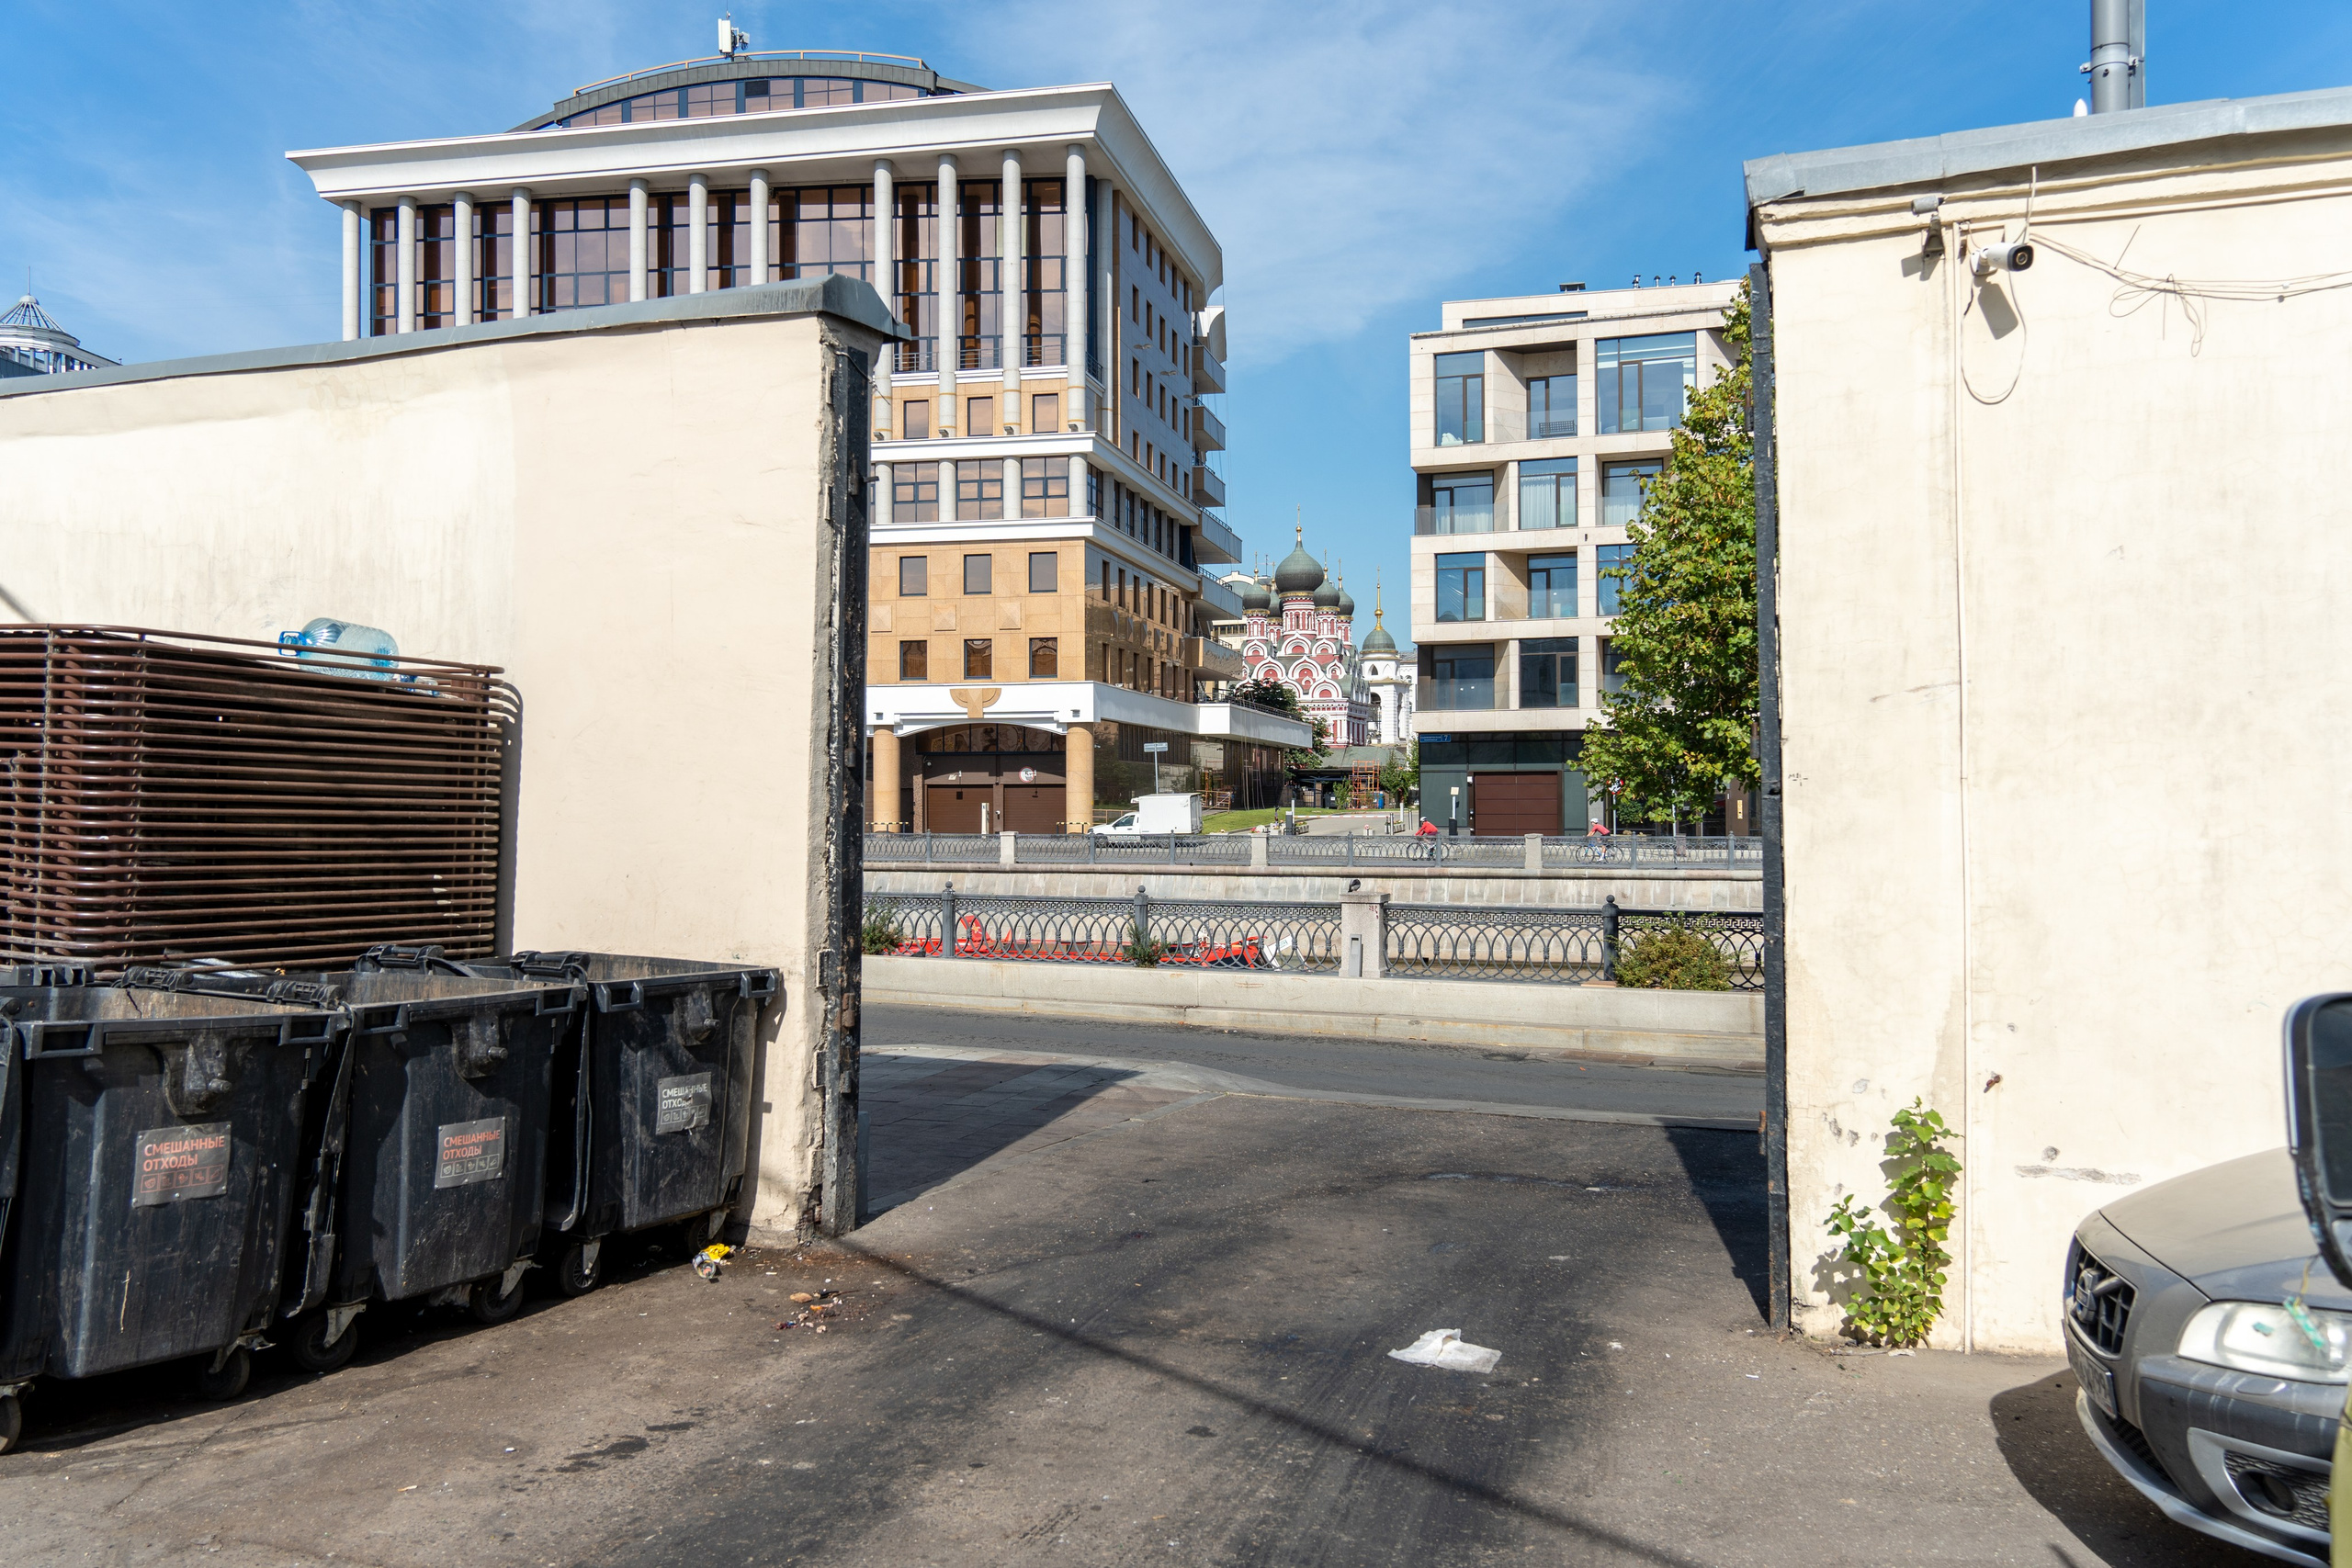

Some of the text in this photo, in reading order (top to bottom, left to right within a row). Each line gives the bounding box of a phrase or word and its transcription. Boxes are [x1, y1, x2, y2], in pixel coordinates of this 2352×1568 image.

[144, 1135, 225, 1156] СМЕШАННЫЕ
[443, 1129, 501, 1147] СМЕШАННЫЕ
[442, 1145, 482, 1160] ОТХОДЫ
[143, 1154, 198, 1172] ОТХОДЫ
